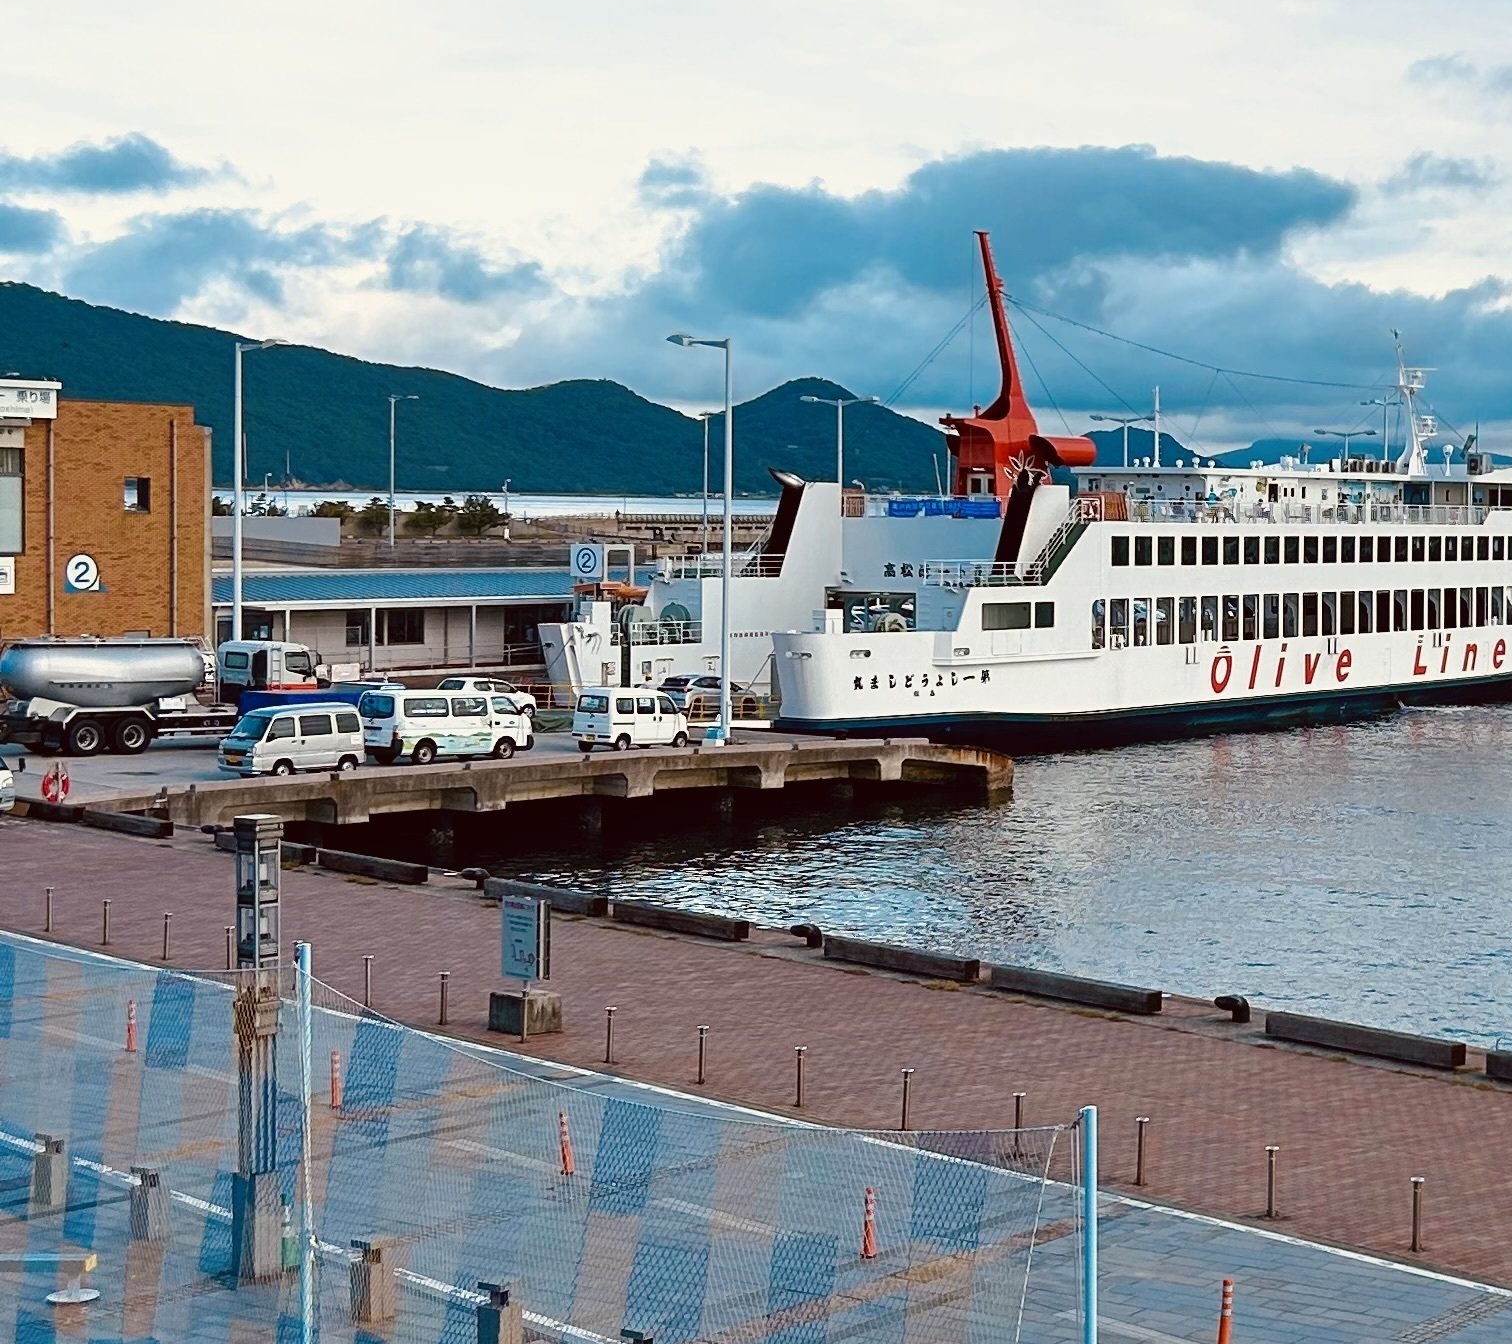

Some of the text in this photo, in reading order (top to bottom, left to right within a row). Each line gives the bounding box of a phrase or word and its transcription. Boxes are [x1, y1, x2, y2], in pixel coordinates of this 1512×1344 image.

[74, 561, 90, 582] 2
[1211, 633, 1506, 694] Olive Line
